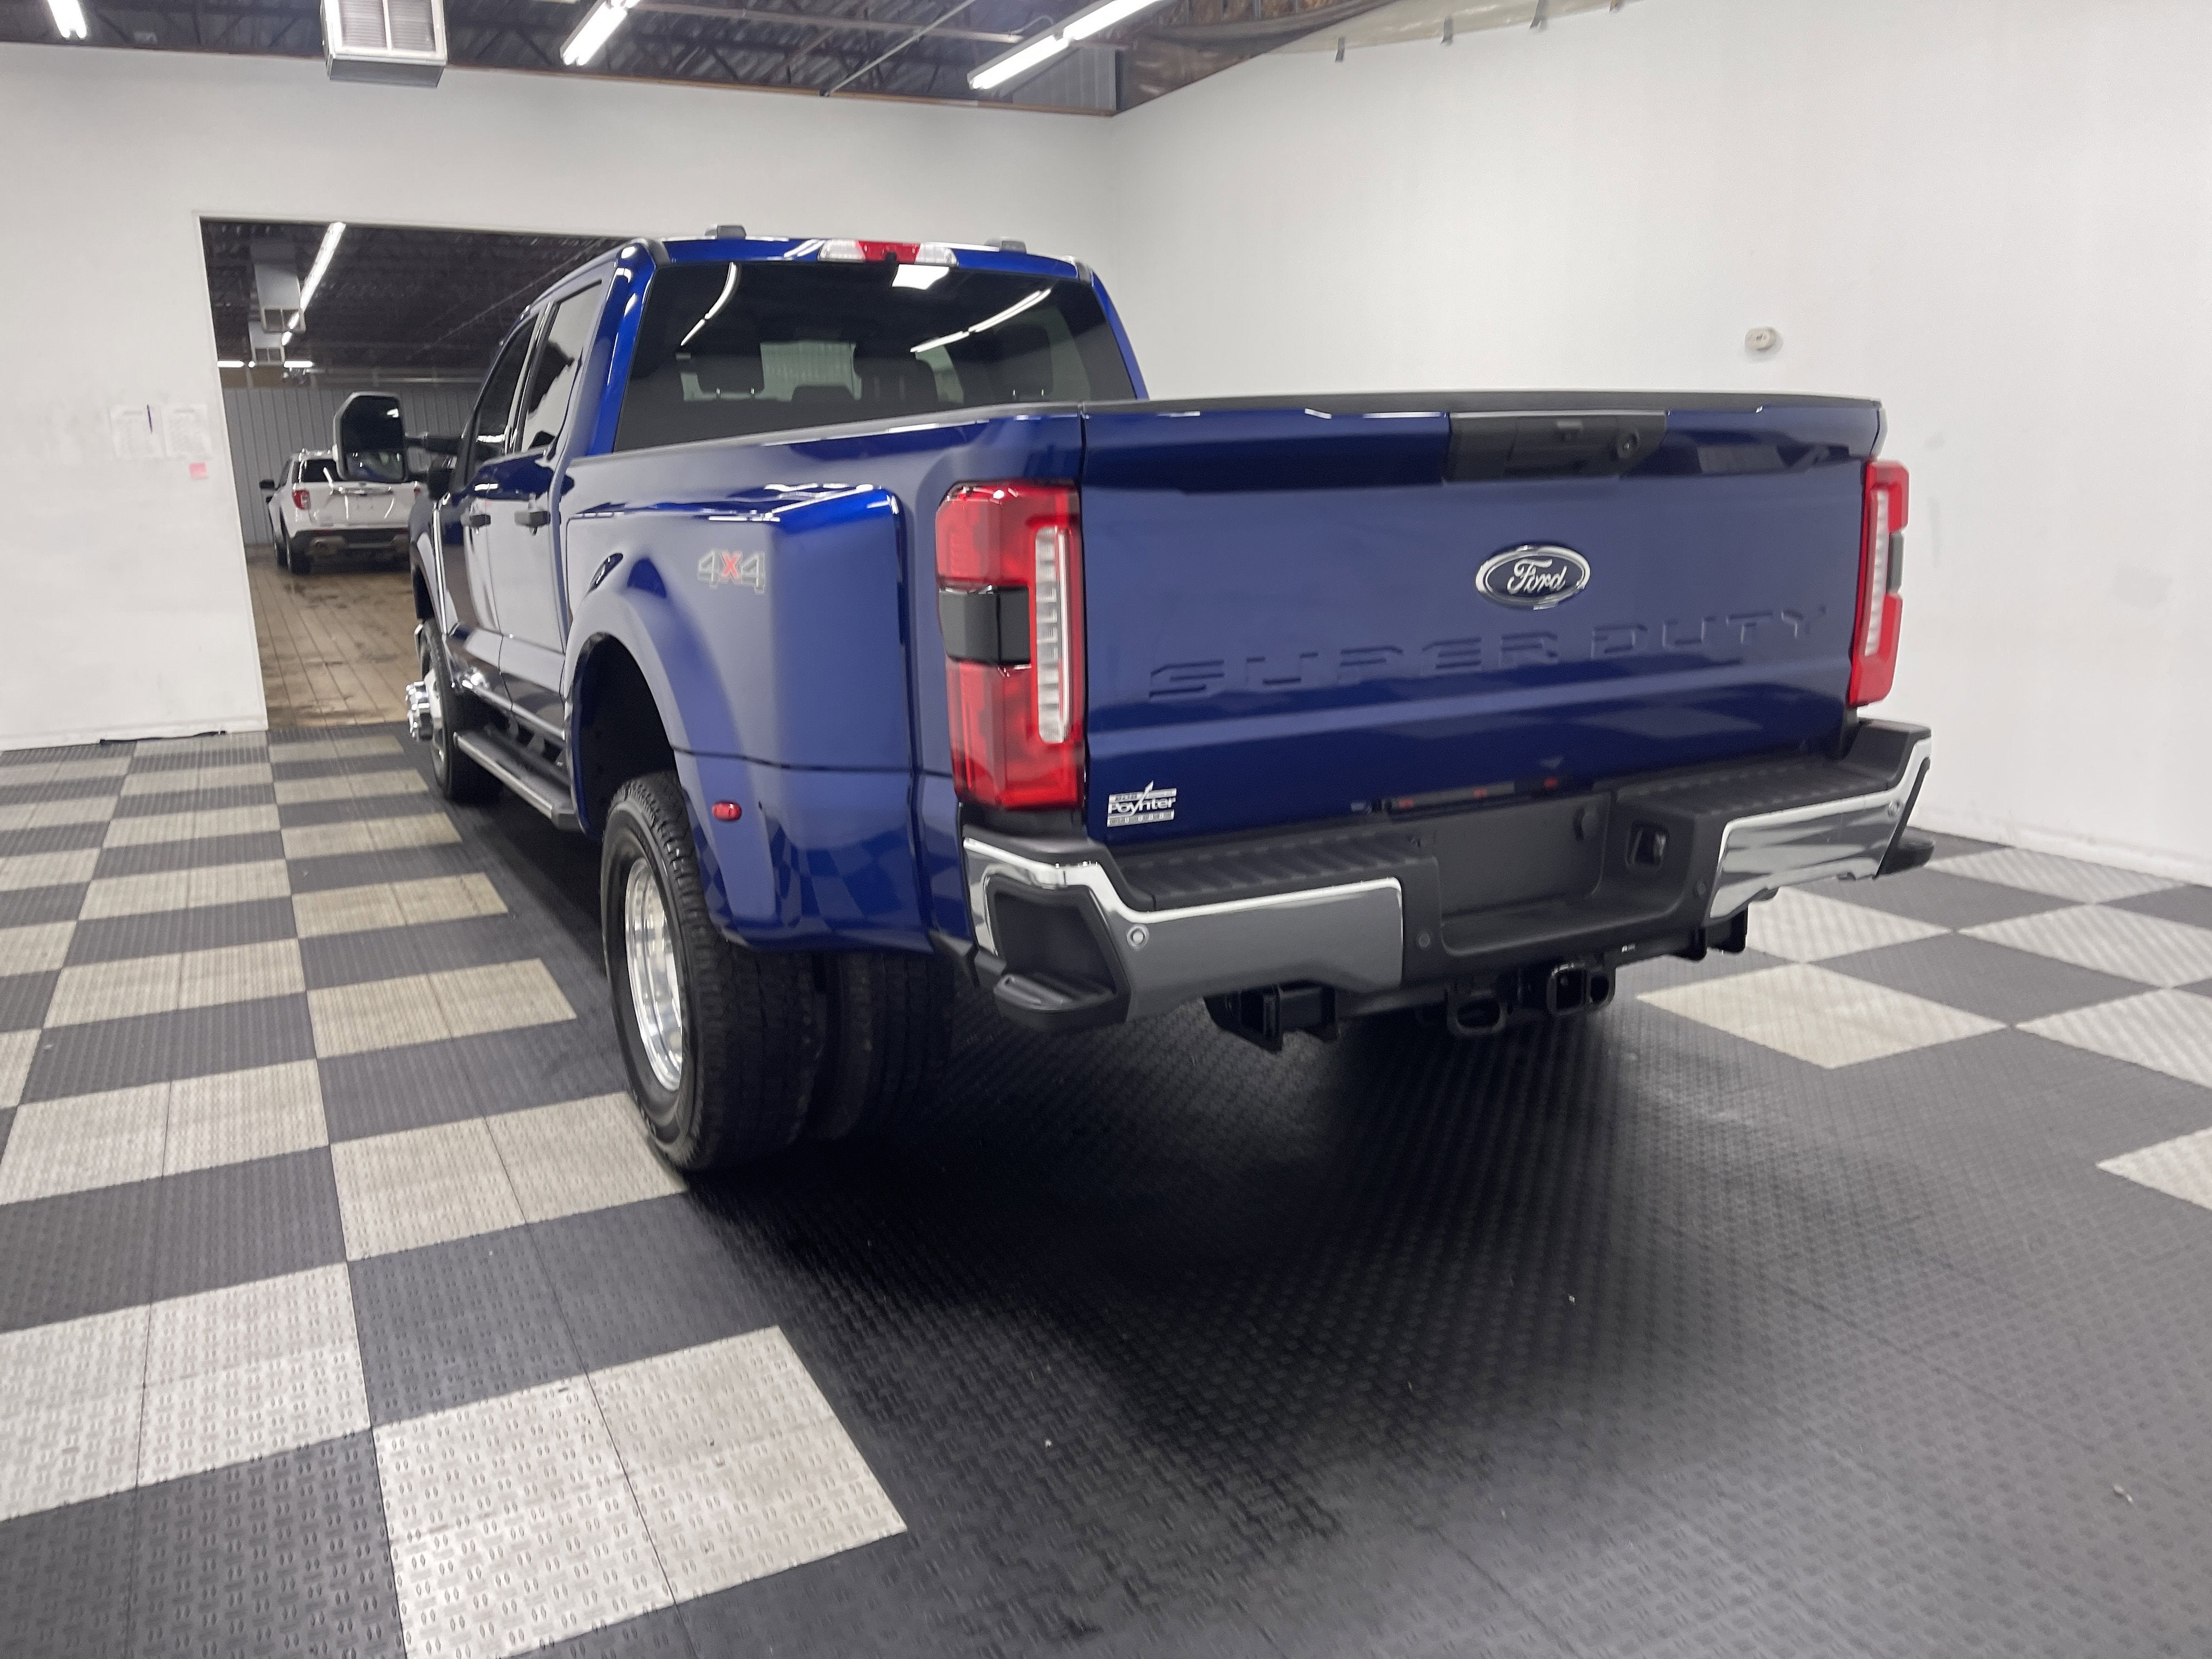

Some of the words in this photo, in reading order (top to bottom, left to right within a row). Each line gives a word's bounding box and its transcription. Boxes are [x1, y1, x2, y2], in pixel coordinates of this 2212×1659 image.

[1507, 558, 1567, 595] Ford
[1149, 632, 1559, 698] SUPER
[1590, 605, 1827, 659] DUTY
[1108, 796, 1176, 817] Poynter
